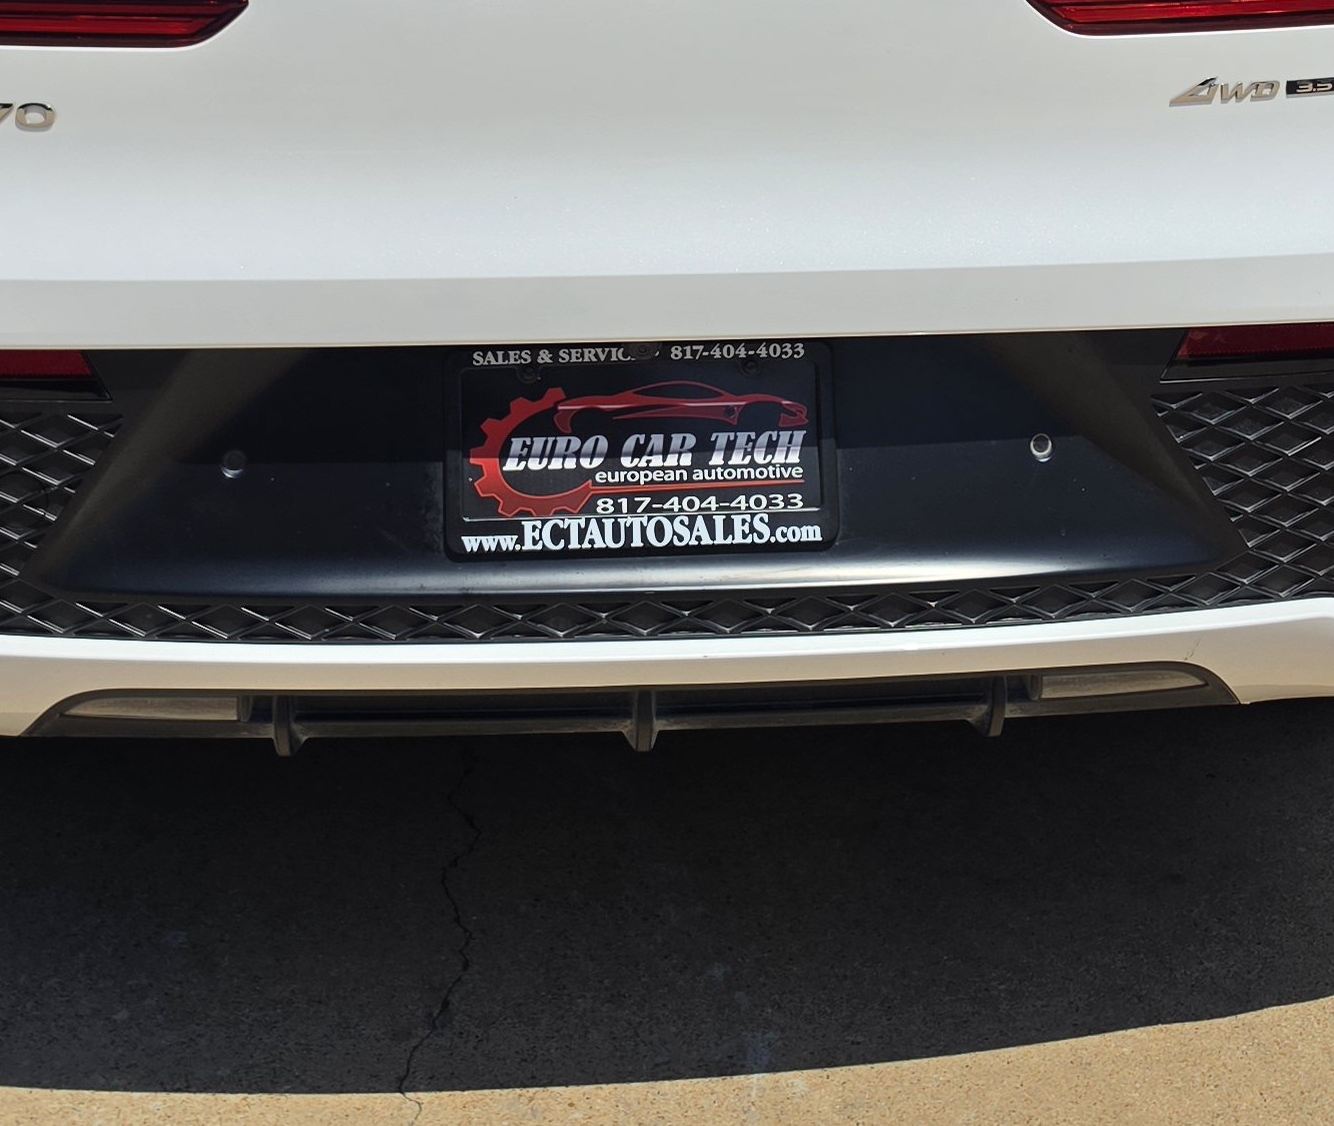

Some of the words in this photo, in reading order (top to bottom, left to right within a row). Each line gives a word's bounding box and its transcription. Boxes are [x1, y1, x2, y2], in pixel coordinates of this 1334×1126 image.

[1169, 77, 1280, 107] 4WD
[472, 348, 532, 366] SALES
[536, 348, 553, 364] &
[558, 345, 637, 363] SERVIC
[670, 342, 805, 360] 817-404-4033
[502, 434, 609, 472] EURO
[620, 433, 698, 468] CAR
[709, 429, 807, 465] TECH
[594, 469, 688, 486] european
[692, 465, 804, 482] automotive
[595, 493, 804, 514] 817-404-4033
[460, 512, 823, 554] www.ECTAUTOSALES.com
